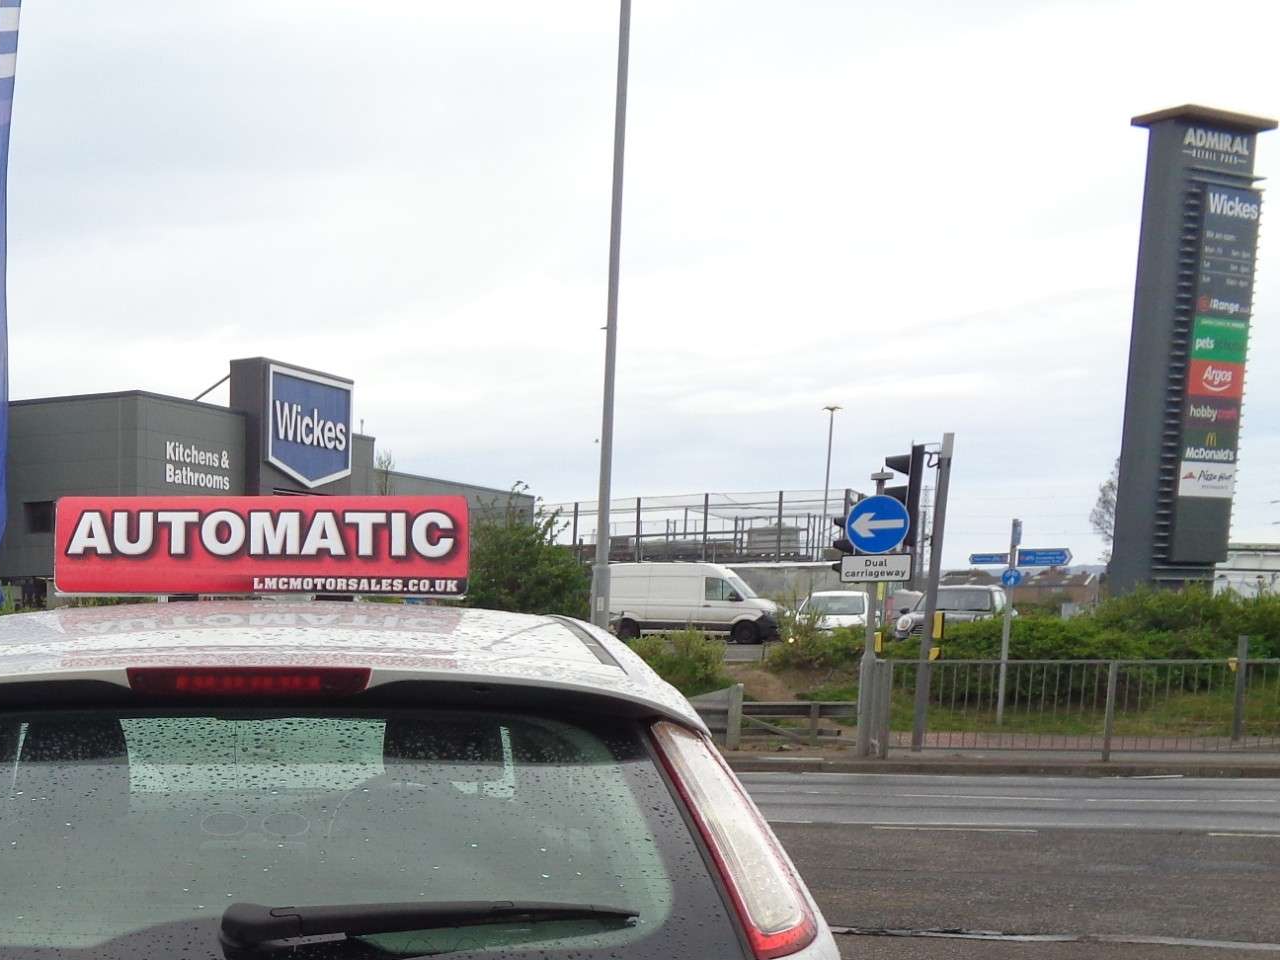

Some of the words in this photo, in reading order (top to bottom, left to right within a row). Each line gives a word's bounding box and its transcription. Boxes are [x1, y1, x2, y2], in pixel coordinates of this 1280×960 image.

[1184, 127, 1249, 155] ADMIRAL
[1210, 192, 1258, 219] Wickes
[1196, 336, 1215, 351] pets
[1203, 365, 1232, 385] Argos
[276, 400, 346, 451] Wickes
[166, 441, 219, 467] Kitchens
[221, 450, 230, 469] &
[1185, 447, 1234, 460] McDonald's
[165, 464, 230, 490] Bathrooms
[67, 512, 454, 558] AUTOMATIC
[844, 567, 907, 578] carriageway
[864, 559, 888, 568] Dual
[253, 577, 458, 592] LMCMOTORSALES.CO.UK
